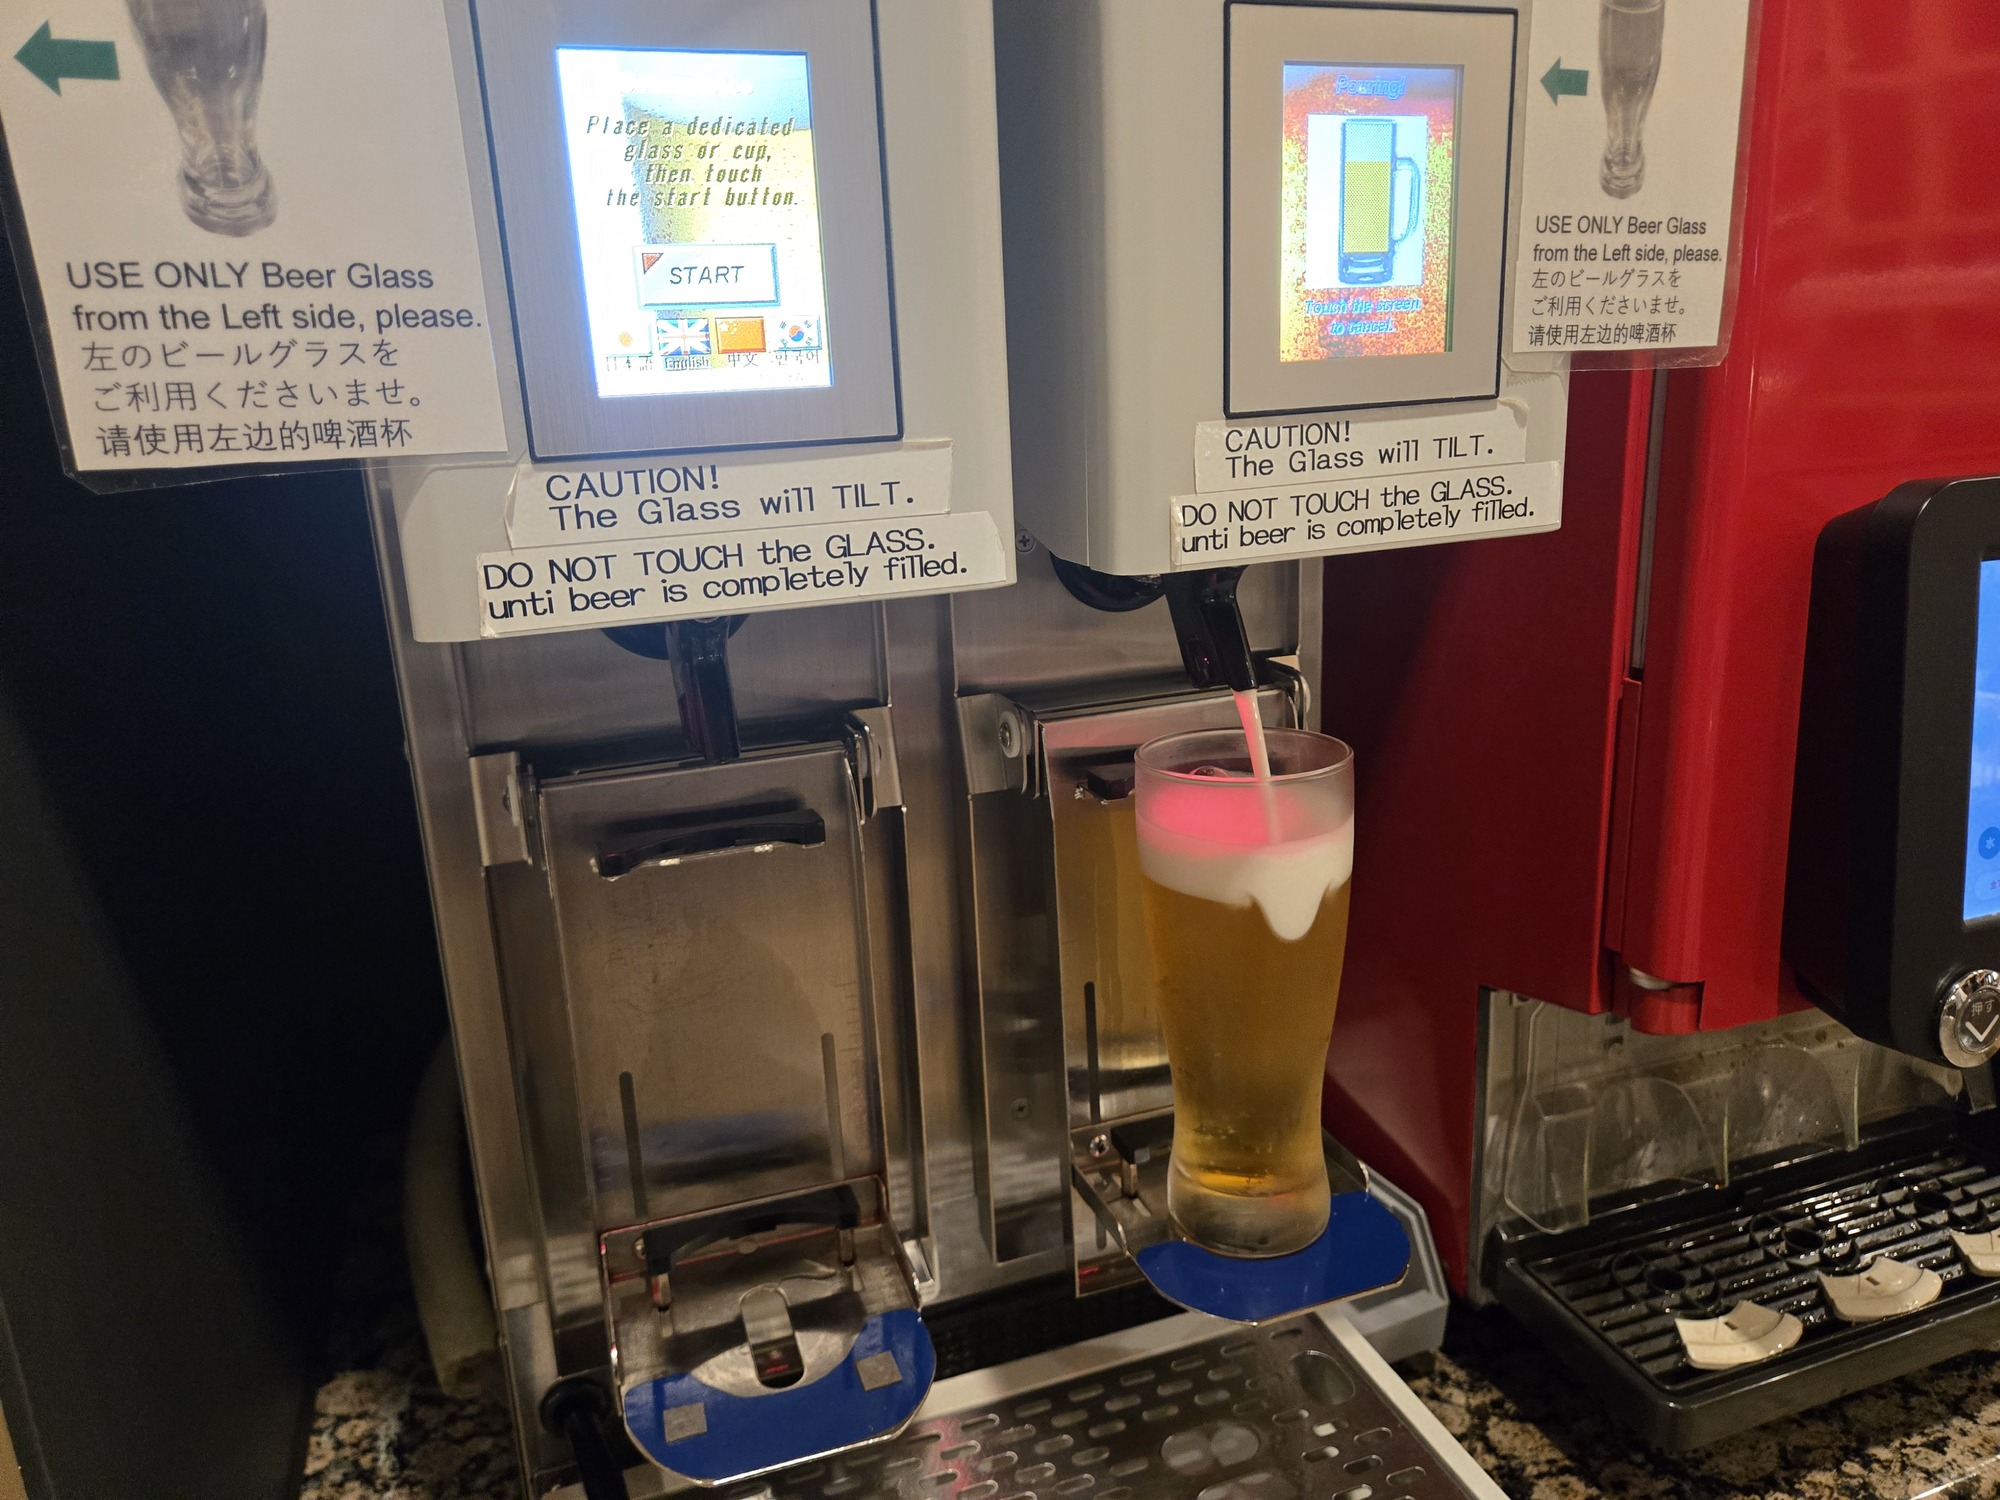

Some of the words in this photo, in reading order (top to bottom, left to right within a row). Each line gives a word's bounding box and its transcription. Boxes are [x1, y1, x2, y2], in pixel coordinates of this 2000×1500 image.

[586, 115, 650, 135] Place
[663, 120, 674, 135] a
[687, 115, 795, 136] dedicated
[624, 139, 684, 162] glass
[697, 143, 719, 158] or
[733, 142, 772, 162] cup,
[645, 164, 691, 183] then
[706, 163, 763, 182] touch
[607, 188, 639, 206] the
[654, 188, 711, 207] start
[725, 187, 799, 206] button.
[1536, 215, 1572, 234] USE
[1577, 215, 1624, 234] ONLY
[1627, 216, 1663, 234] Beer
[1666, 216, 1707, 235] Glass
[1533, 243, 1568, 261] from
[1574, 243, 1597, 261] the
[1602, 243, 1631, 261] Left
[1635, 244, 1669, 264] side,
[1672, 245, 1722, 265] please.
[65, 261, 144, 289] USE
[154, 261, 249, 289] ONLY
[262, 262, 336, 289] Beer
[347, 262, 434, 289] Glass
[669, 266, 744, 285] START
[1531, 267, 1682, 289] 左のビールグラスを
[1305, 299, 1347, 315] Touch
[1352, 299, 1372, 313] the
[1376, 297, 1421, 312] screen
[1532, 294, 1686, 317] ご利用くださいませ。
[73, 303, 149, 331] from
[159, 304, 210, 330] the
[222, 302, 280, 329] Left
[292, 302, 365, 332] side,
[376, 302, 482, 334] please.
[1330, 319, 1344, 335] to
[1528, 321, 1678, 347] 请使用左边的啤酒杯
[82, 338, 400, 372] 左のビールグラスを
[665, 354, 710, 371] English
[727, 352, 759, 368] 中文
[94, 379, 422, 413] ご利用くださいませ。
[96, 418, 413, 457] 请使用左边的啤酒杯
[1225, 420, 1351, 453] CAUTION!
[1225, 455, 1274, 479] The
[1288, 448, 1364, 473] Glass
[1378, 438, 1419, 464] will
[1433, 434, 1494, 460] TILT.
[545, 465, 720, 501] CAUTION!
[549, 505, 618, 532] The
[638, 497, 741, 525] Glass
[760, 486, 814, 515] will
[832, 481, 915, 512] TILT.
[1181, 502, 1217, 528] DO
[1228, 497, 1279, 523] NOT
[1290, 488, 1370, 515] TOUCH
[1380, 485, 1420, 507] the
[1430, 475, 1513, 502] GLASS.
[1181, 526, 1229, 553] unti
[1239, 521, 1296, 547] beer
[1306, 519, 1326, 540] is
[1336, 504, 1461, 537] completely
[1471, 497, 1535, 522] filled.
[483, 562, 533, 590] DO
[548, 554, 618, 584] NOT
[633, 543, 744, 577] TOUCH
[757, 538, 812, 565] the
[824, 527, 936, 560] GLASS.
[488, 589, 554, 620] unti
[570, 583, 645, 612] beer
[662, 579, 688, 603] is
[703, 562, 869, 600] completely
[883, 552, 968, 582] filled.
[1972, 999, 1995, 1017] 押す
